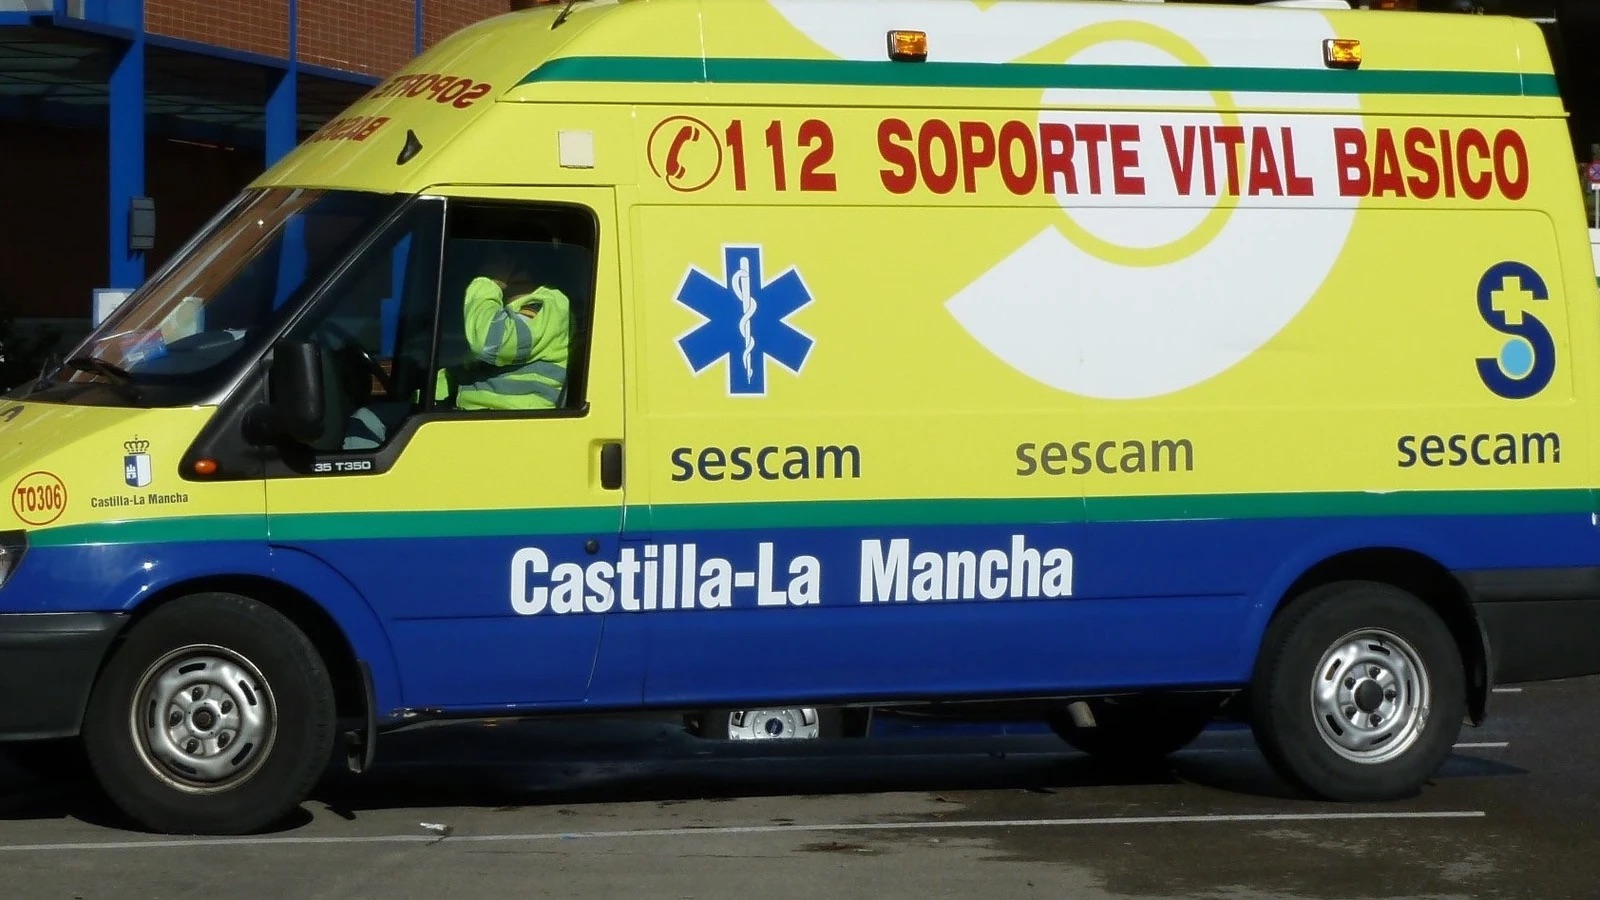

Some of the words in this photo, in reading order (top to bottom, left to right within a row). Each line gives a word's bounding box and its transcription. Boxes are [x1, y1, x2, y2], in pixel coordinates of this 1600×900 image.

[725, 119, 838, 192] 112
[877, 118, 1146, 196] SOPORTE
[1160, 125, 1314, 198] VITAL
[1333, 127, 1530, 201] BASICO
[335, 461, 371, 471] T350
[671, 444, 861, 482] sescam
[1015, 437, 1194, 477] sescam
[1397, 432, 1561, 468] sescam
[91, 494, 146, 508] Castilla-La
[148, 492, 189, 505] Mancha
[510, 542, 820, 615] Castilla-La
[859, 534, 1074, 604] Mancha
